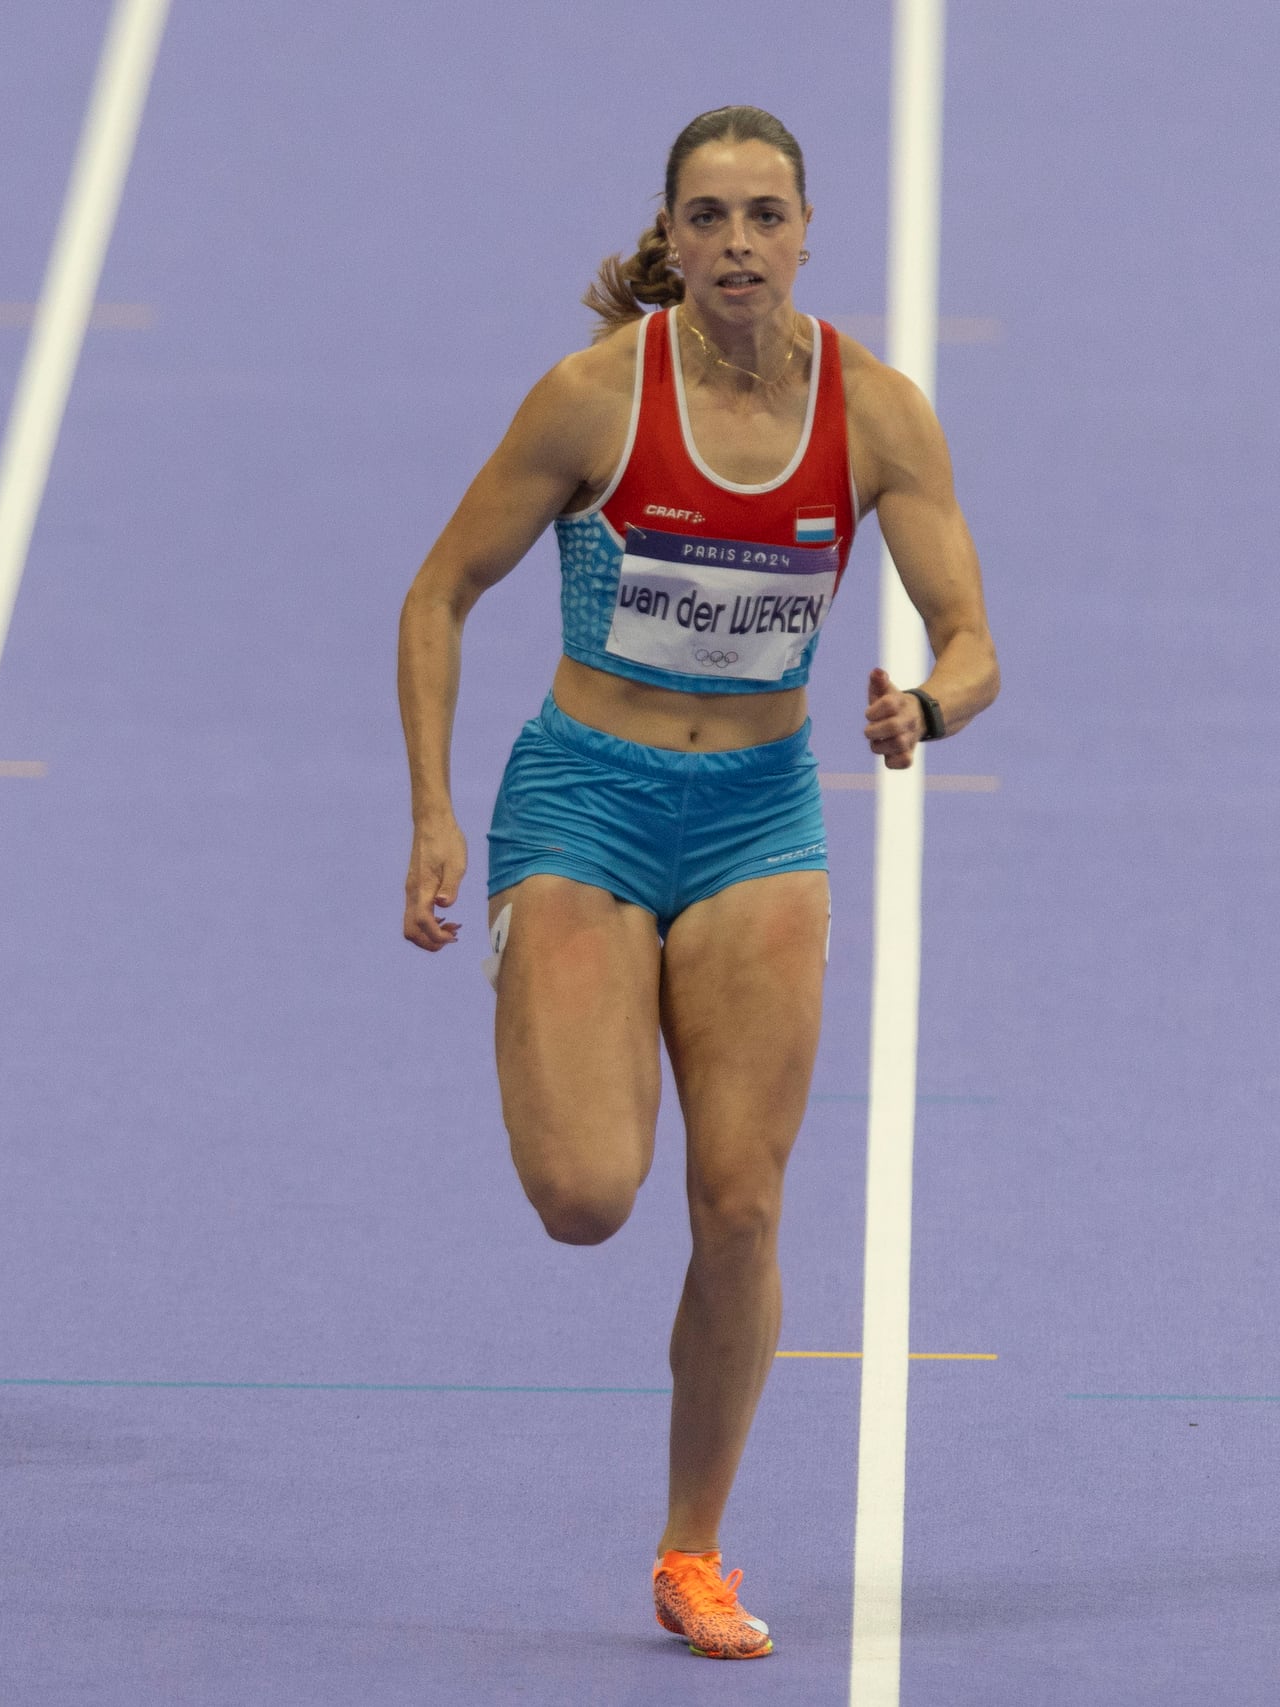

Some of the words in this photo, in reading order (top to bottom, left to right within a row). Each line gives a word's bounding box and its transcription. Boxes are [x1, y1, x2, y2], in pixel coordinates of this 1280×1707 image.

[646, 504, 694, 521] CRAFT
[742, 552, 790, 567] 2024
[619, 584, 670, 620] van
[676, 589, 726, 632] der
[729, 594, 825, 635] WEKEN
